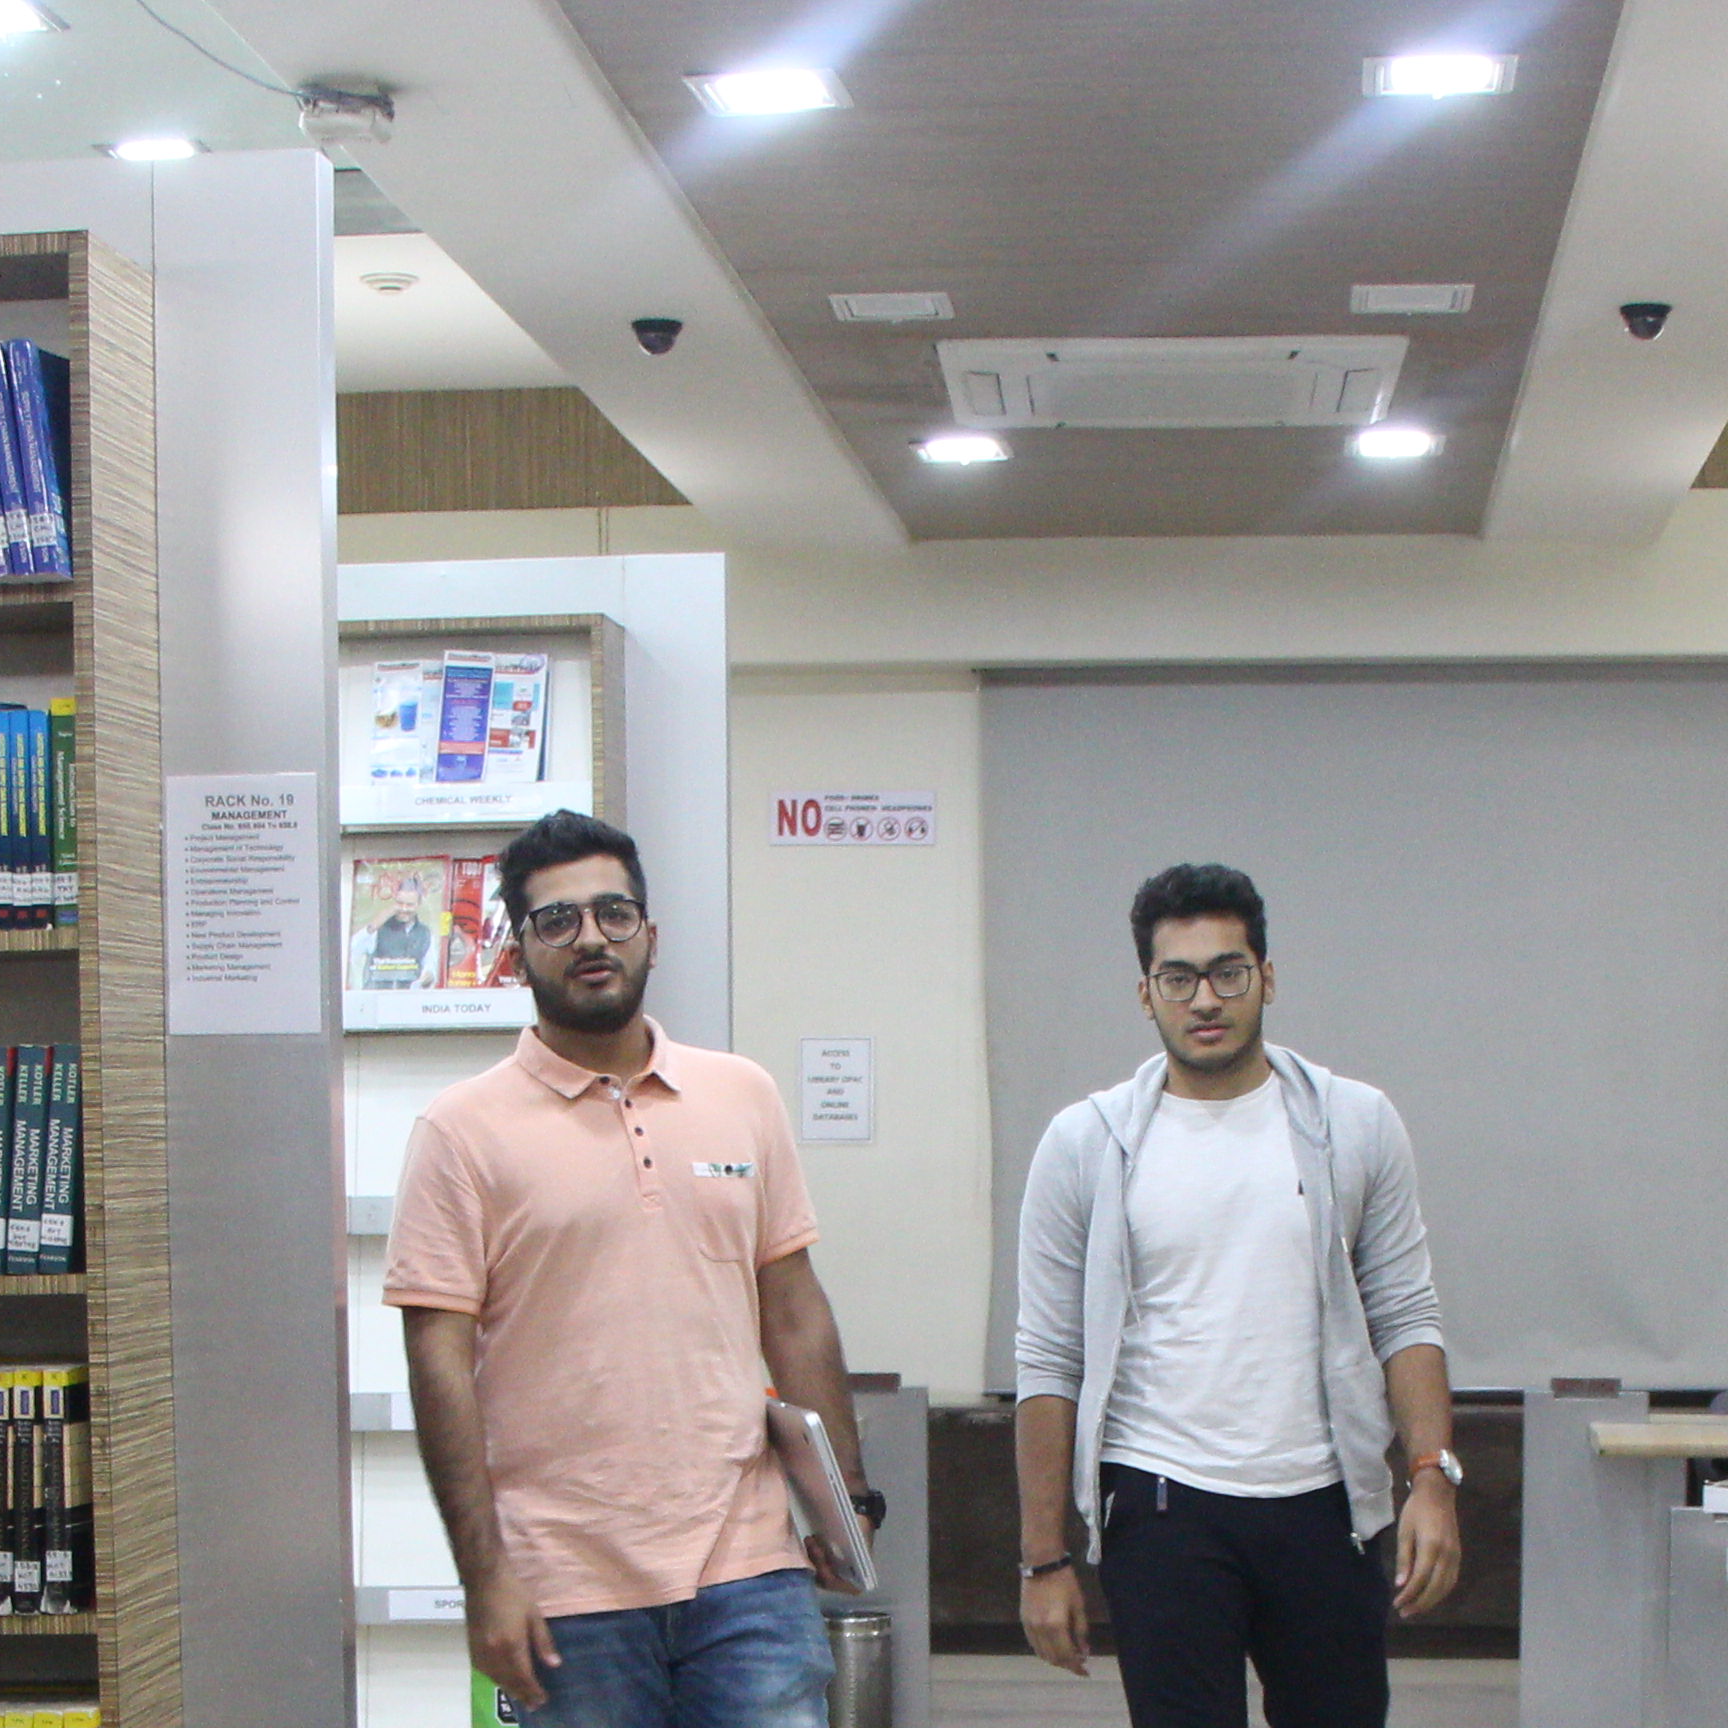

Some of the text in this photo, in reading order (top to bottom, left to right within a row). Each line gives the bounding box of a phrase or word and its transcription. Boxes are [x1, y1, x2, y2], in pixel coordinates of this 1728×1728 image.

[205, 794, 246, 807] RACK
[251, 794, 274, 807] No.
[212, 810, 288, 821] MANAGEMENT
[415, 794, 512, 806] CHEMICAL WEEKLY
[777, 798, 822, 837] NO
[422, 1003, 492, 1014] INDIA TODAY
[17, 1064, 29, 1104] KELLER
[33, 1064, 44, 1104] KOTLER
[51, 1063, 63, 1101] KELLER
[67, 1062, 79, 1104] KOTLER
[9, 1119, 27, 1213] MANAGEMENT
[25, 1128, 42, 1205] MARKETING
[43, 1119, 60, 1211] MANAGEMENT
[57, 1128, 74, 1205] MARKETING
[434, 1600, 465, 1609] SPOR
